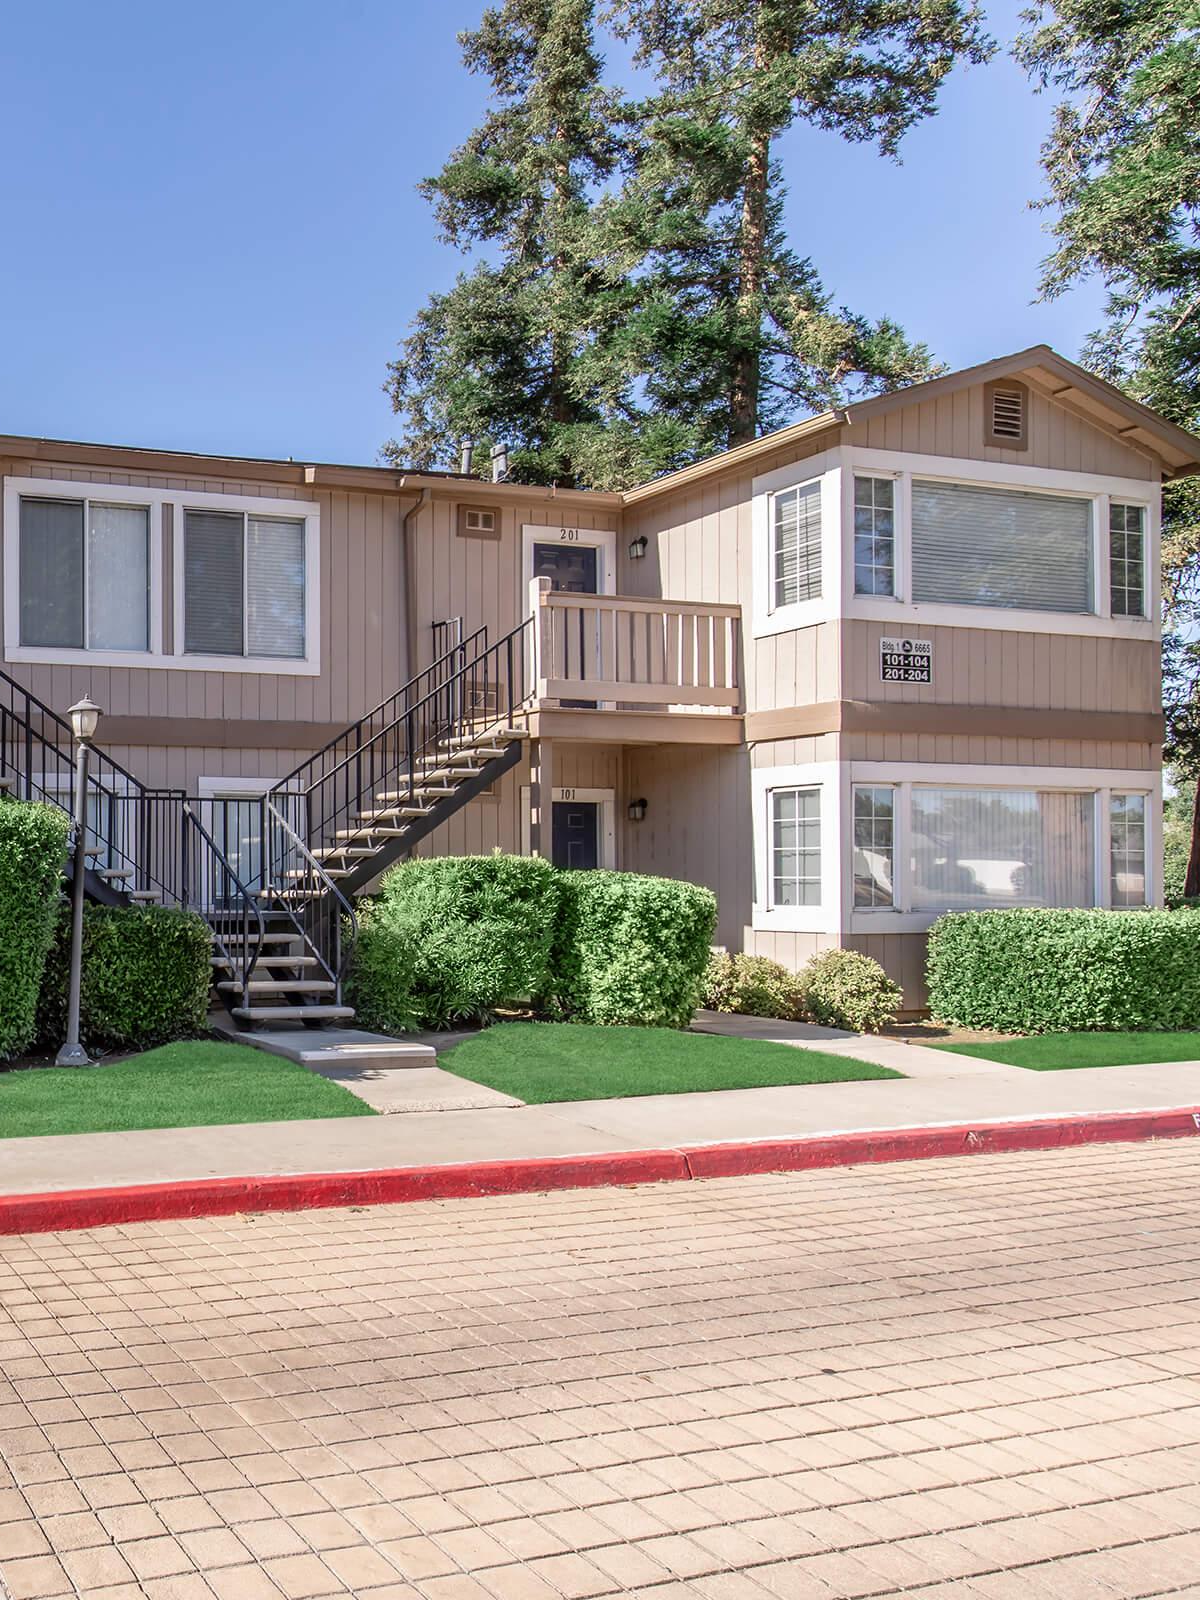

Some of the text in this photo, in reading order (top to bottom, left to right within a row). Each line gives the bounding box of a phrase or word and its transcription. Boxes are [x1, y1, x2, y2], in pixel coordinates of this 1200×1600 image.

[560, 528, 579, 541] 201
[914, 643, 931, 653] 6665
[885, 654, 929, 667] 101-104
[885, 668, 929, 681] 201-204
[561, 789, 576, 801] 101
